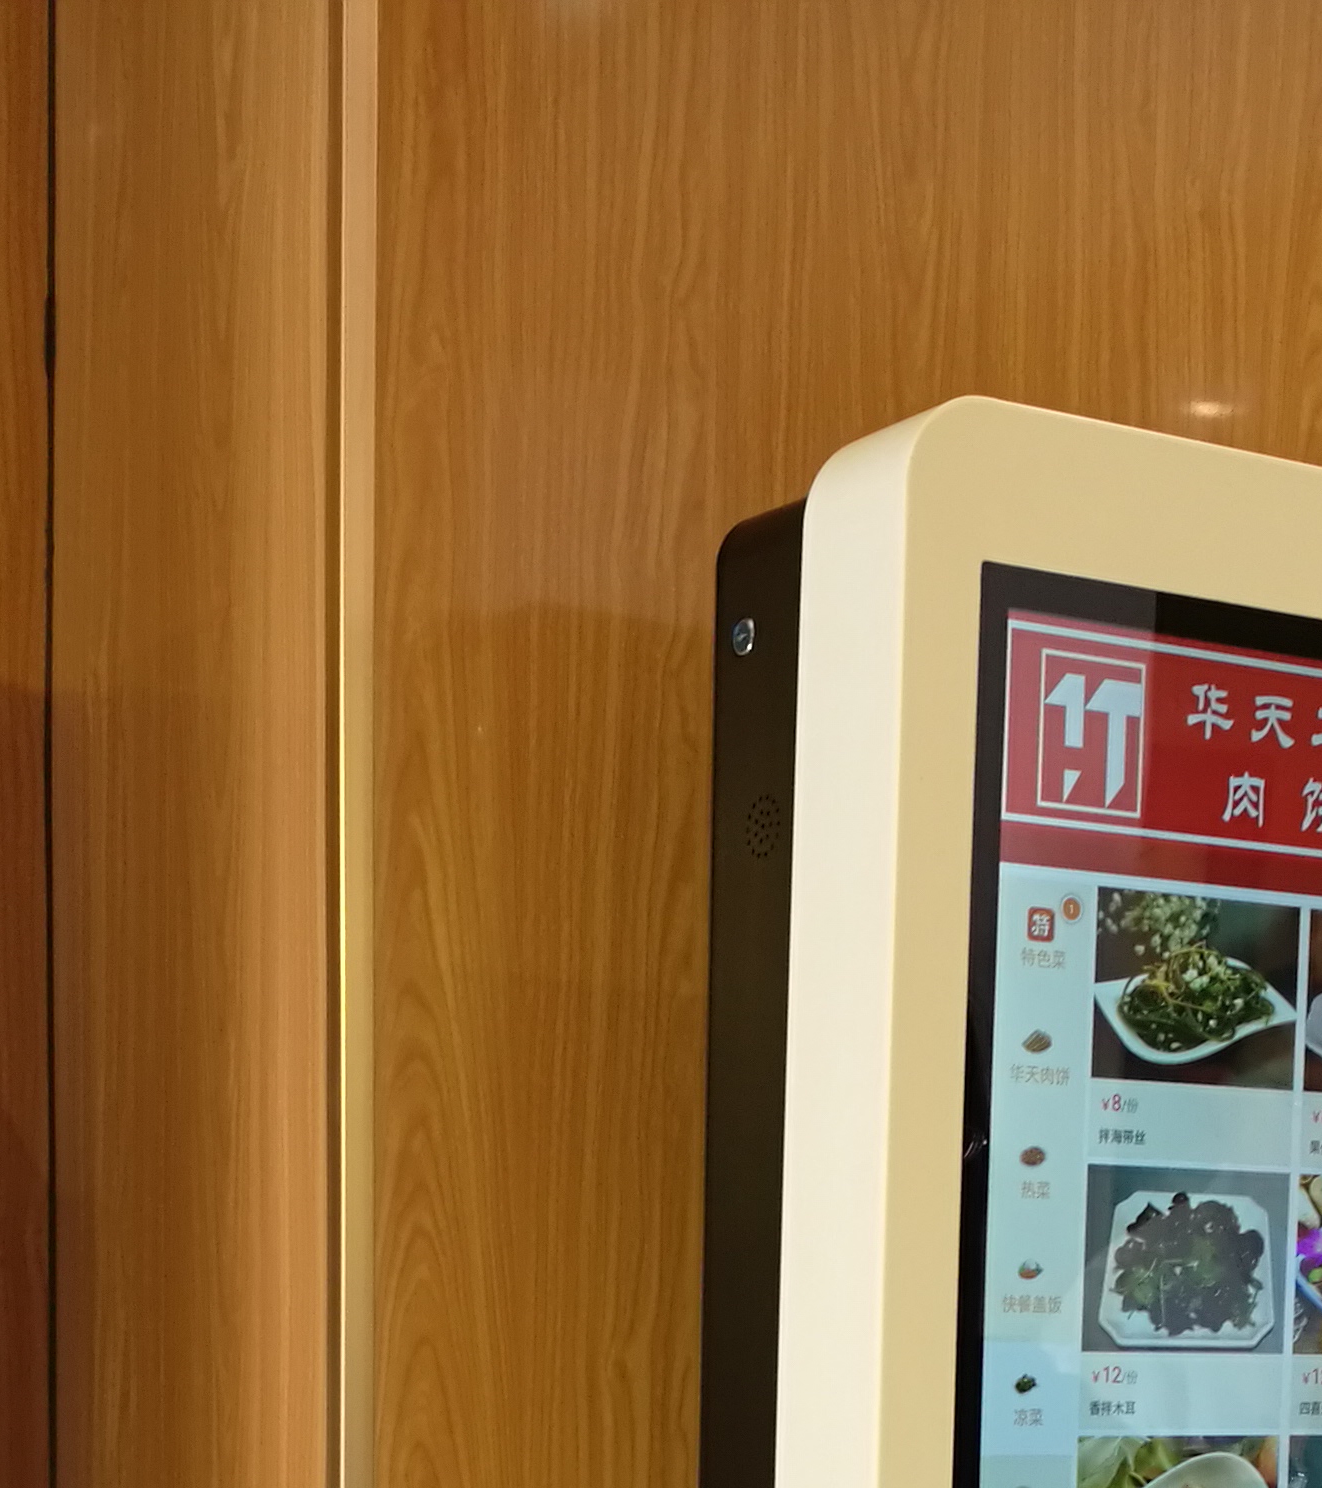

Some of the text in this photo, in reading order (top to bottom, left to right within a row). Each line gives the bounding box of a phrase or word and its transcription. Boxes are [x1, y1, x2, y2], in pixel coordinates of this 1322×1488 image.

[1020, 946, 1067, 970] 特色菜
[1009, 1063, 1070, 1087] 华天肉饼
[1001, 1294, 1063, 1314] 快餐盖饭
[1013, 1407, 1044, 1427] 凉菜
